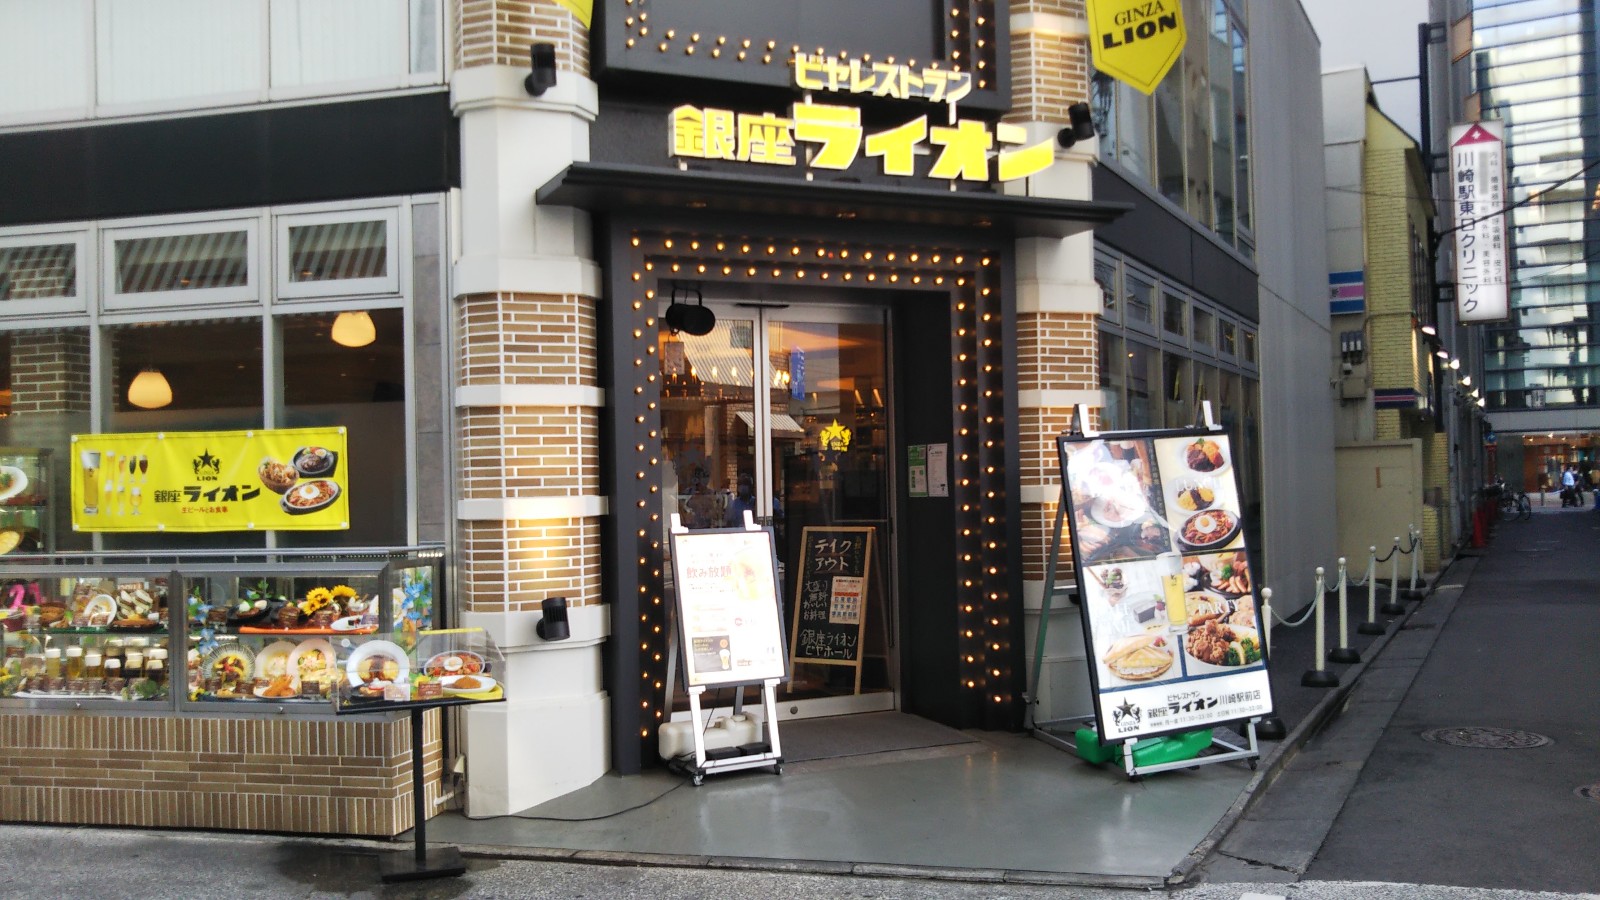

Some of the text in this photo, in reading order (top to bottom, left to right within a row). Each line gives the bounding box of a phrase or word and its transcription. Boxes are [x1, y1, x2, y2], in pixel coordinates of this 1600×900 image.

[1114, 0, 1164, 26] GINZA
[1102, 12, 1177, 49] LION
[795, 52, 972, 102] ビヤレストラン
[668, 103, 1055, 182] 銀座ライオン
[1457, 151, 1479, 313] 川崎駅東口クリニック
[153, 485, 261, 503] 銀座ライオン
[814, 538, 852, 555] テイク
[686, 564, 732, 579] 飲み放題
[815, 557, 849, 571] アウト
[800, 629, 857, 647] 銀座ライオン
[805, 645, 853, 659] ビヤホール
[1167, 691, 1200, 702] ビヤレストラン
[1118, 726, 1140, 734] LION
